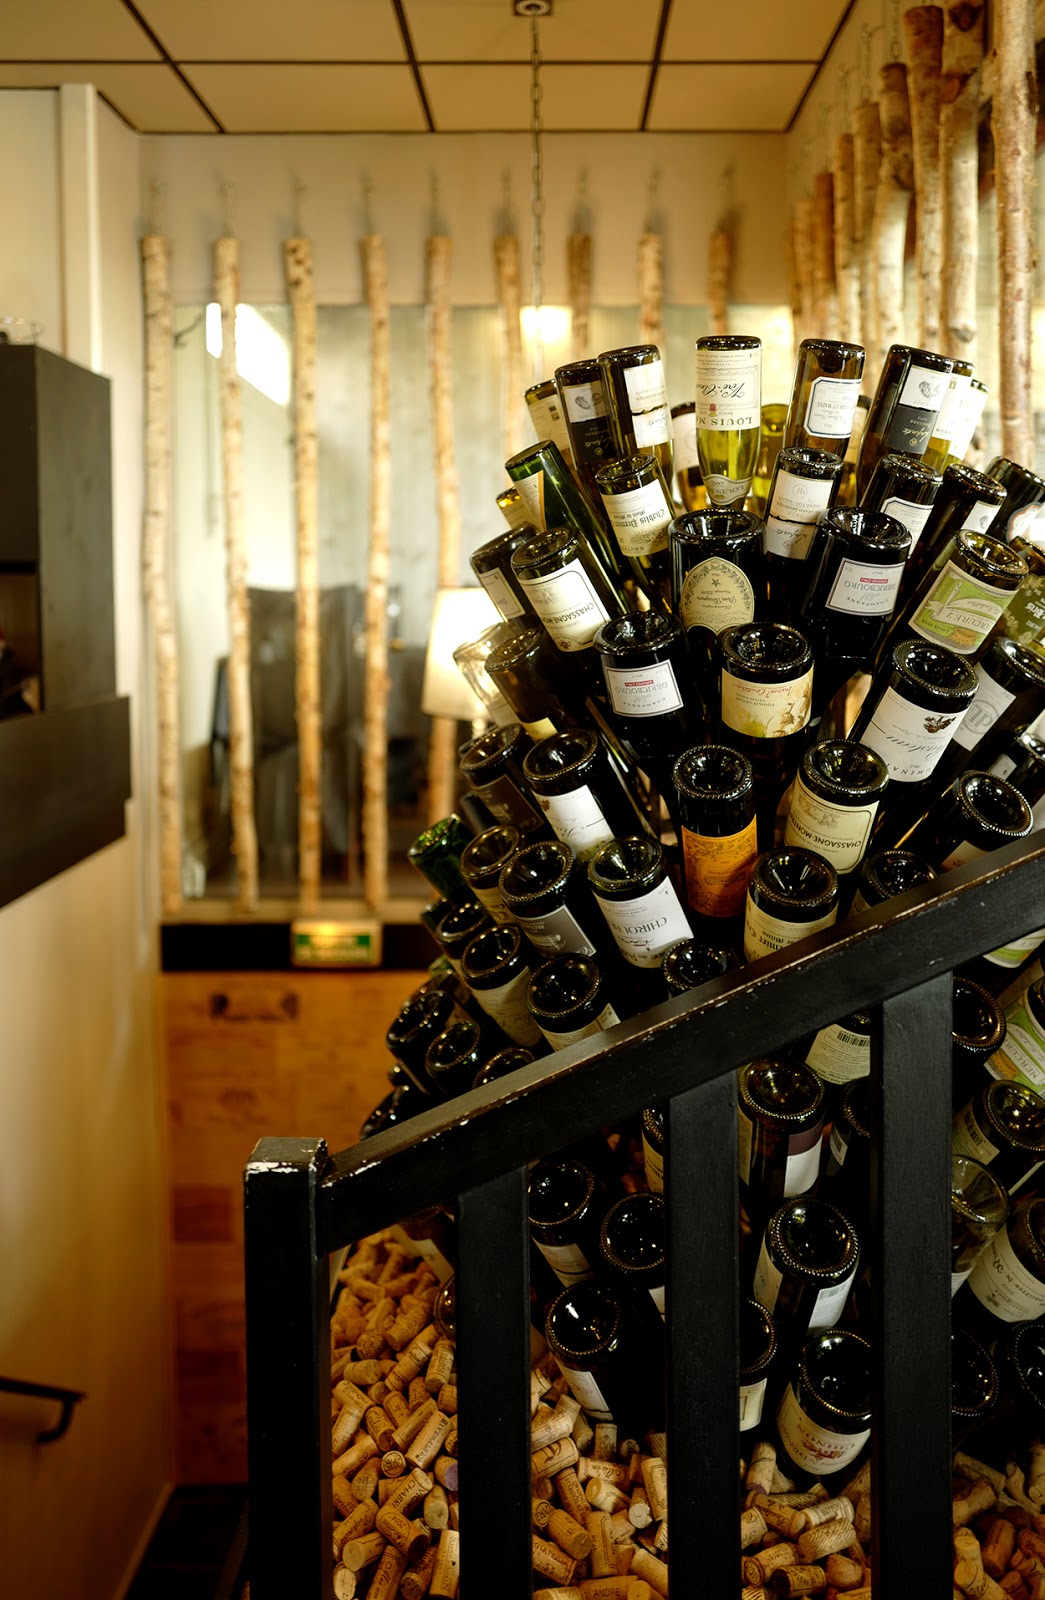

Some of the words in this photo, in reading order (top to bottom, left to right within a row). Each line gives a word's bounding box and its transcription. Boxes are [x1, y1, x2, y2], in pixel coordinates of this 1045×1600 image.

[710, 416, 751, 424] LOUIS
[718, 485, 743, 493] LOUIS
[639, 508, 665, 524] Chablis
[773, 525, 807, 545] Laporte
[842, 580, 895, 590] DERICBOURG
[695, 594, 720, 603] Pérignon
[721, 595, 736, 603] Dom
[845, 595, 887, 605] CHAMPAGNE
[615, 680, 667, 693] DERICBOURG
[623, 696, 665, 707] CHAMPAGNE
[761, 930, 785, 943] Milieu
[796, 1424, 853, 1450] CHINON
[593, 1588, 620, 1596] ANDRE
